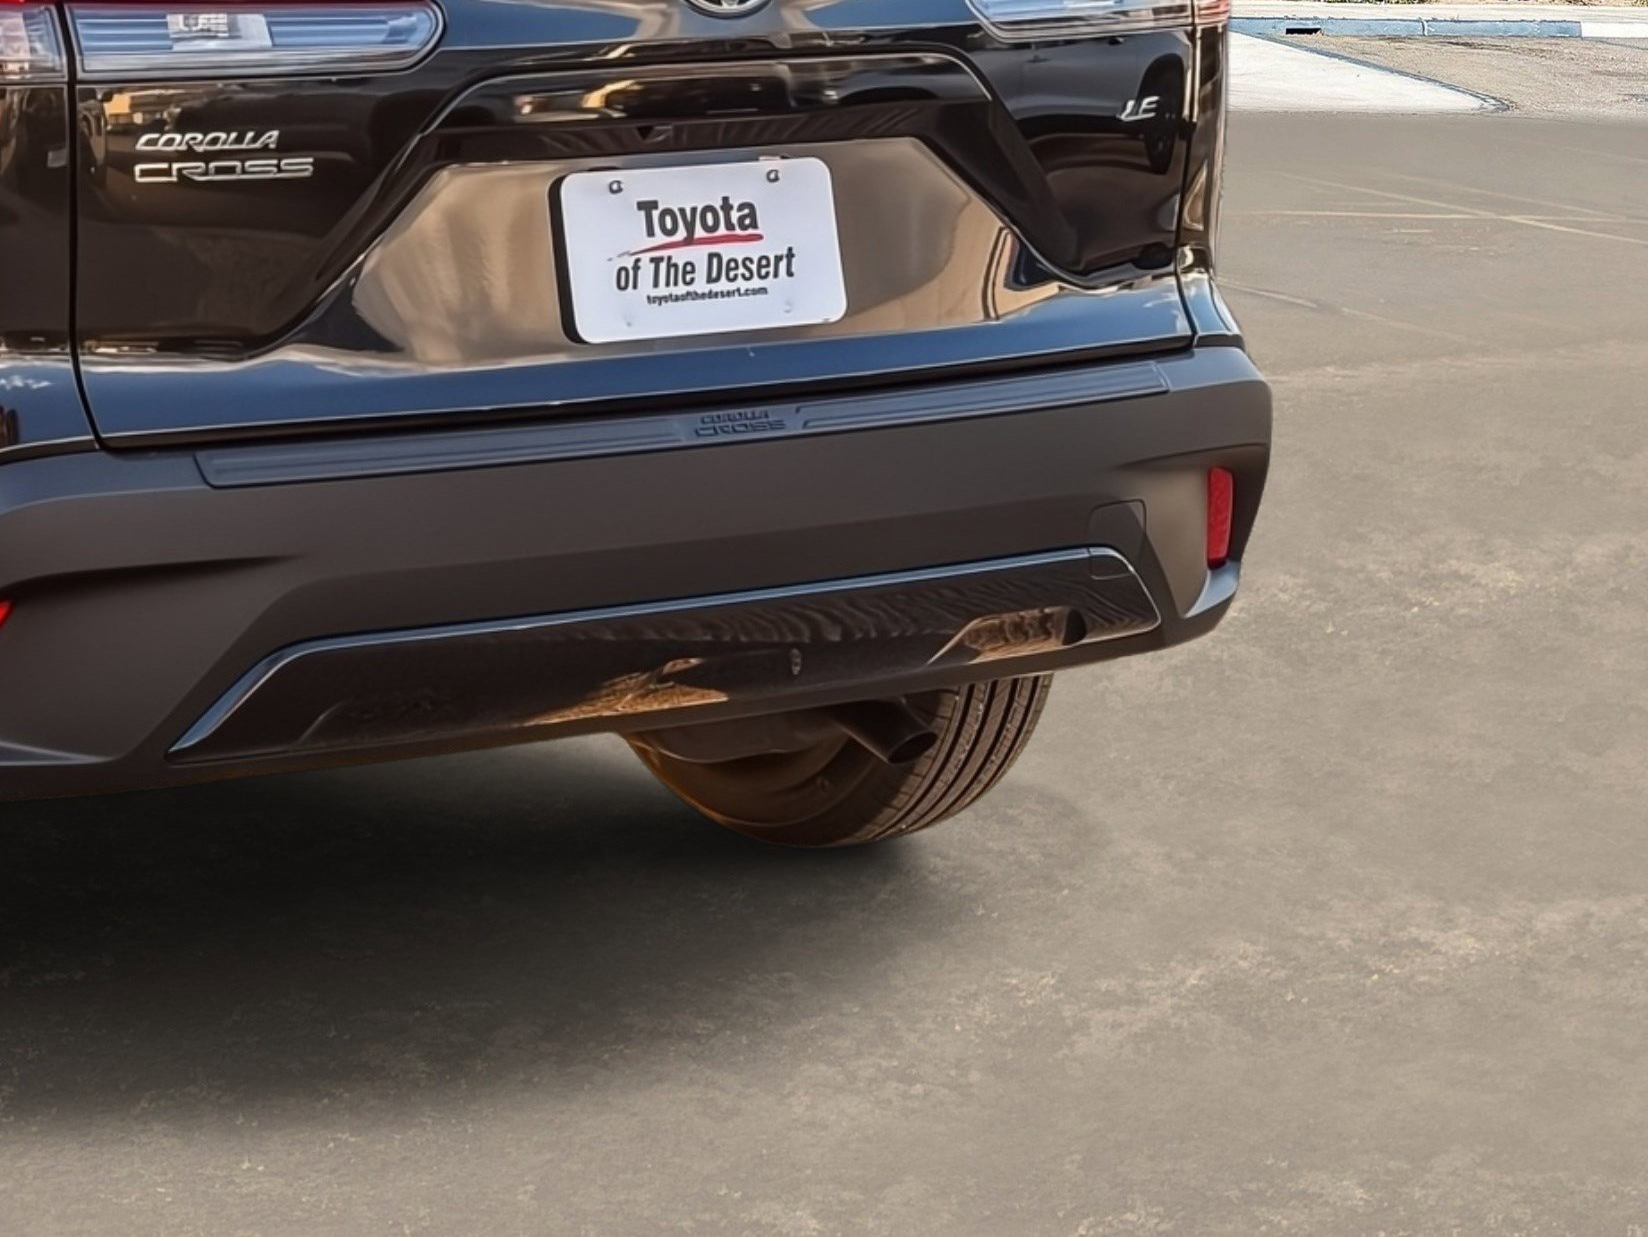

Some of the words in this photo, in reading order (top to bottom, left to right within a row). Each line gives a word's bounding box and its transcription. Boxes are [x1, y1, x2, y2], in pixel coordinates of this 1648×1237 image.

[1120, 95, 1160, 122] LE
[135, 130, 280, 152] COROLLA
[134, 157, 314, 183] CROSS
[637, 196, 759, 246] Toyota
[616, 258, 641, 291] of
[649, 255, 696, 289] The
[706, 246, 796, 285] Desert
[646, 286, 768, 306] toyotaofthedesert.com
